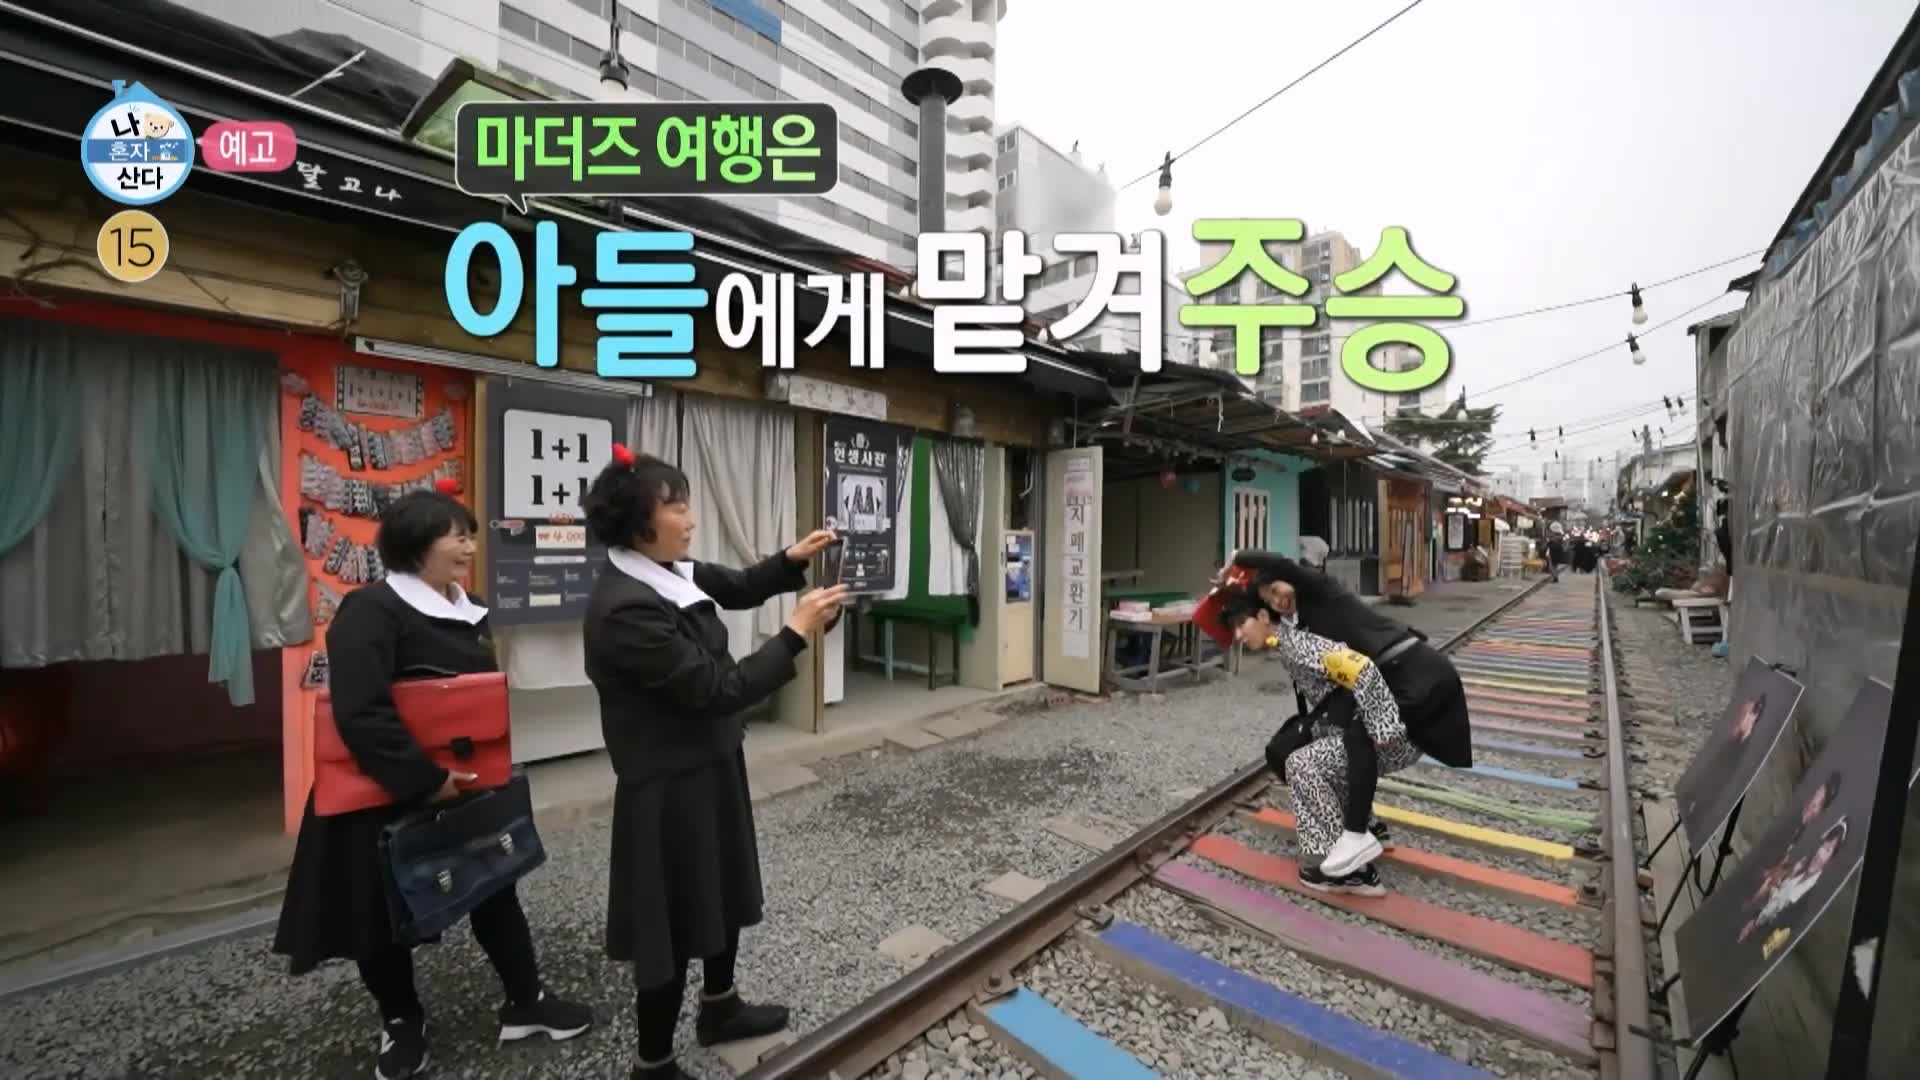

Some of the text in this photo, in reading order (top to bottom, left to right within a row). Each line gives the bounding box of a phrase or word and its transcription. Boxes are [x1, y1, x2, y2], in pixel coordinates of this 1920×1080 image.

[296, 161, 402, 202] 달고나
[531, 429, 589, 463] 1+1
[834, 447, 886, 467] 인생사진
[531, 475, 588, 506] 1+1
